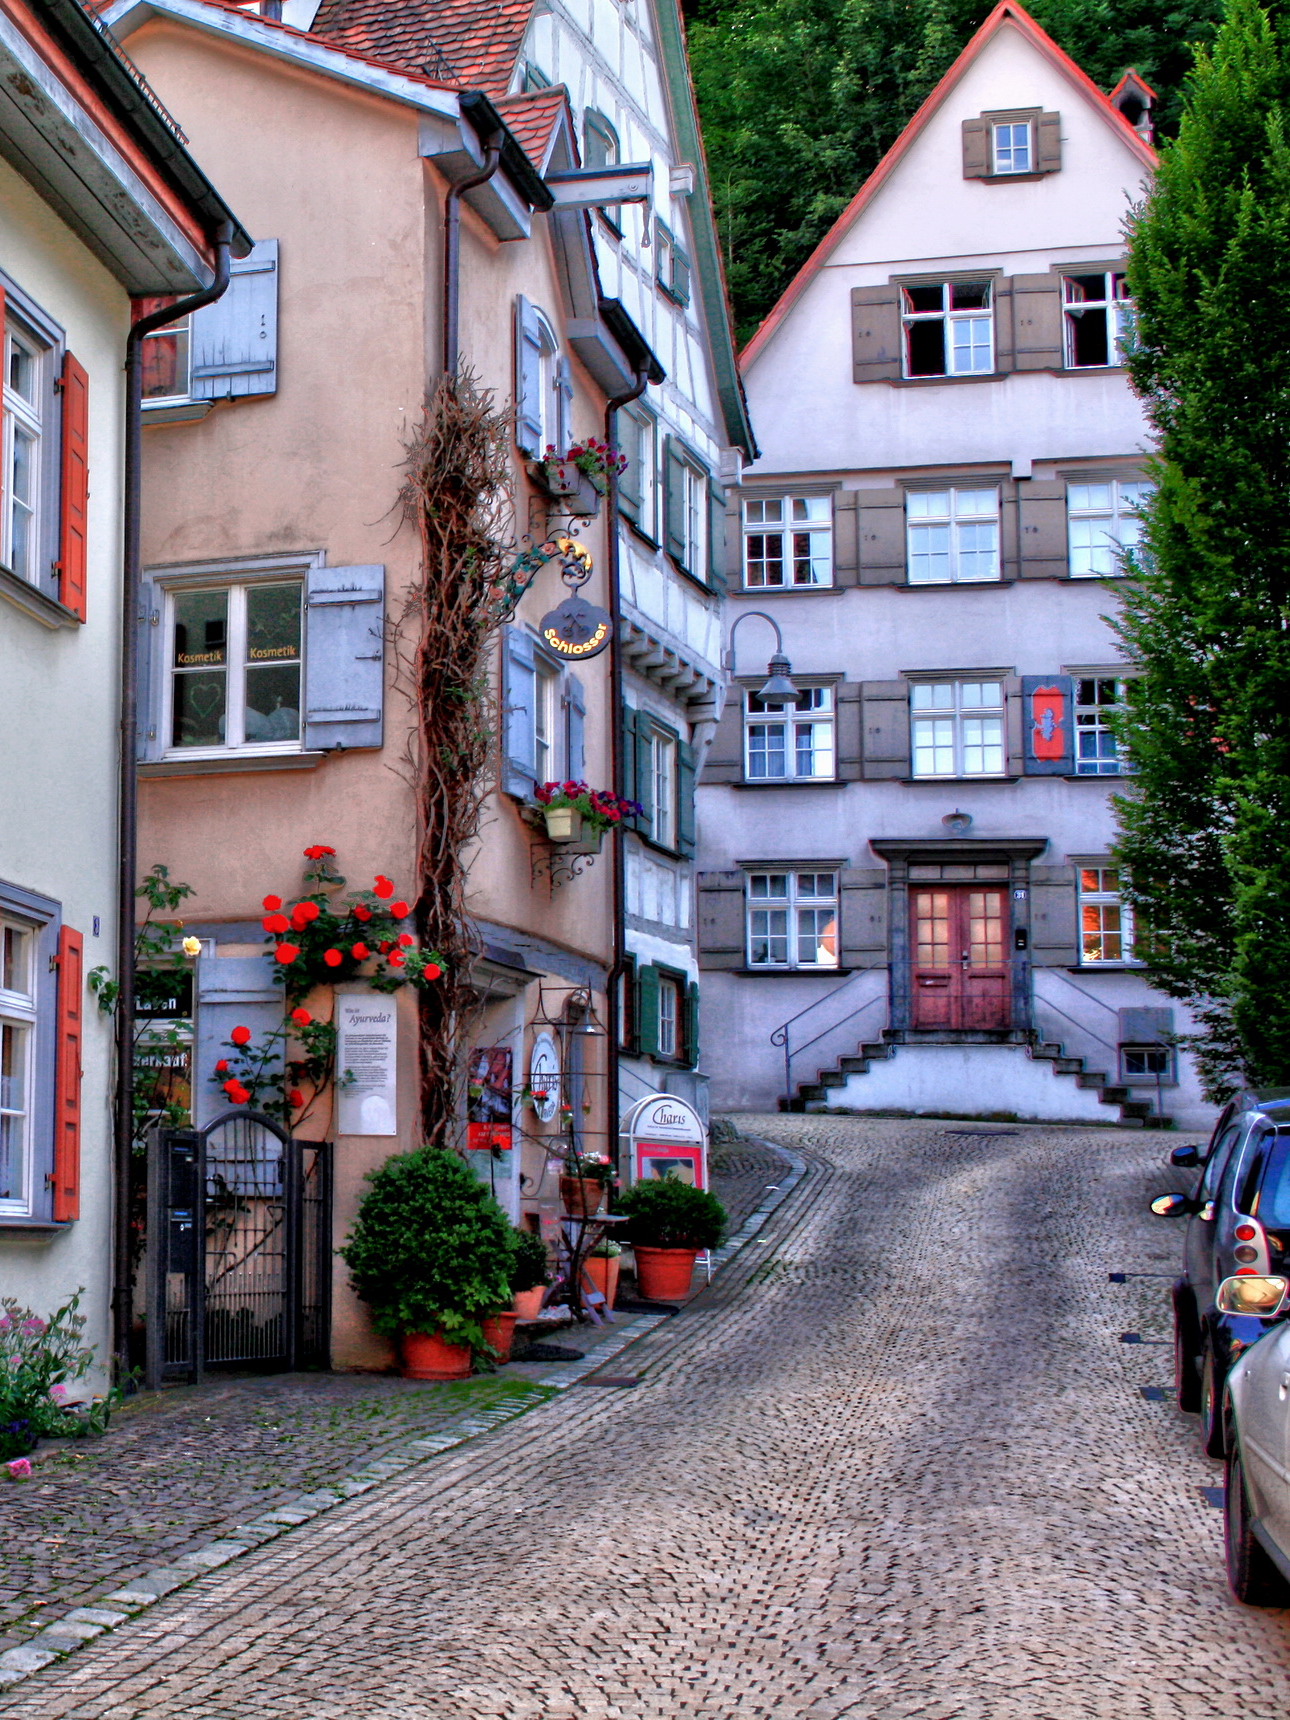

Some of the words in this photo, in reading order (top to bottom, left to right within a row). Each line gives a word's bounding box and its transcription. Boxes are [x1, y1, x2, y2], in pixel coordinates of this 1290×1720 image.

[544, 623, 608, 655] Schlosser
[177, 650, 222, 664] Kosmetik
[249, 645, 296, 659] Kosmetik
[349, 1012, 391, 1027] Ayurveda?
[652, 1104, 686, 1126] Charis
